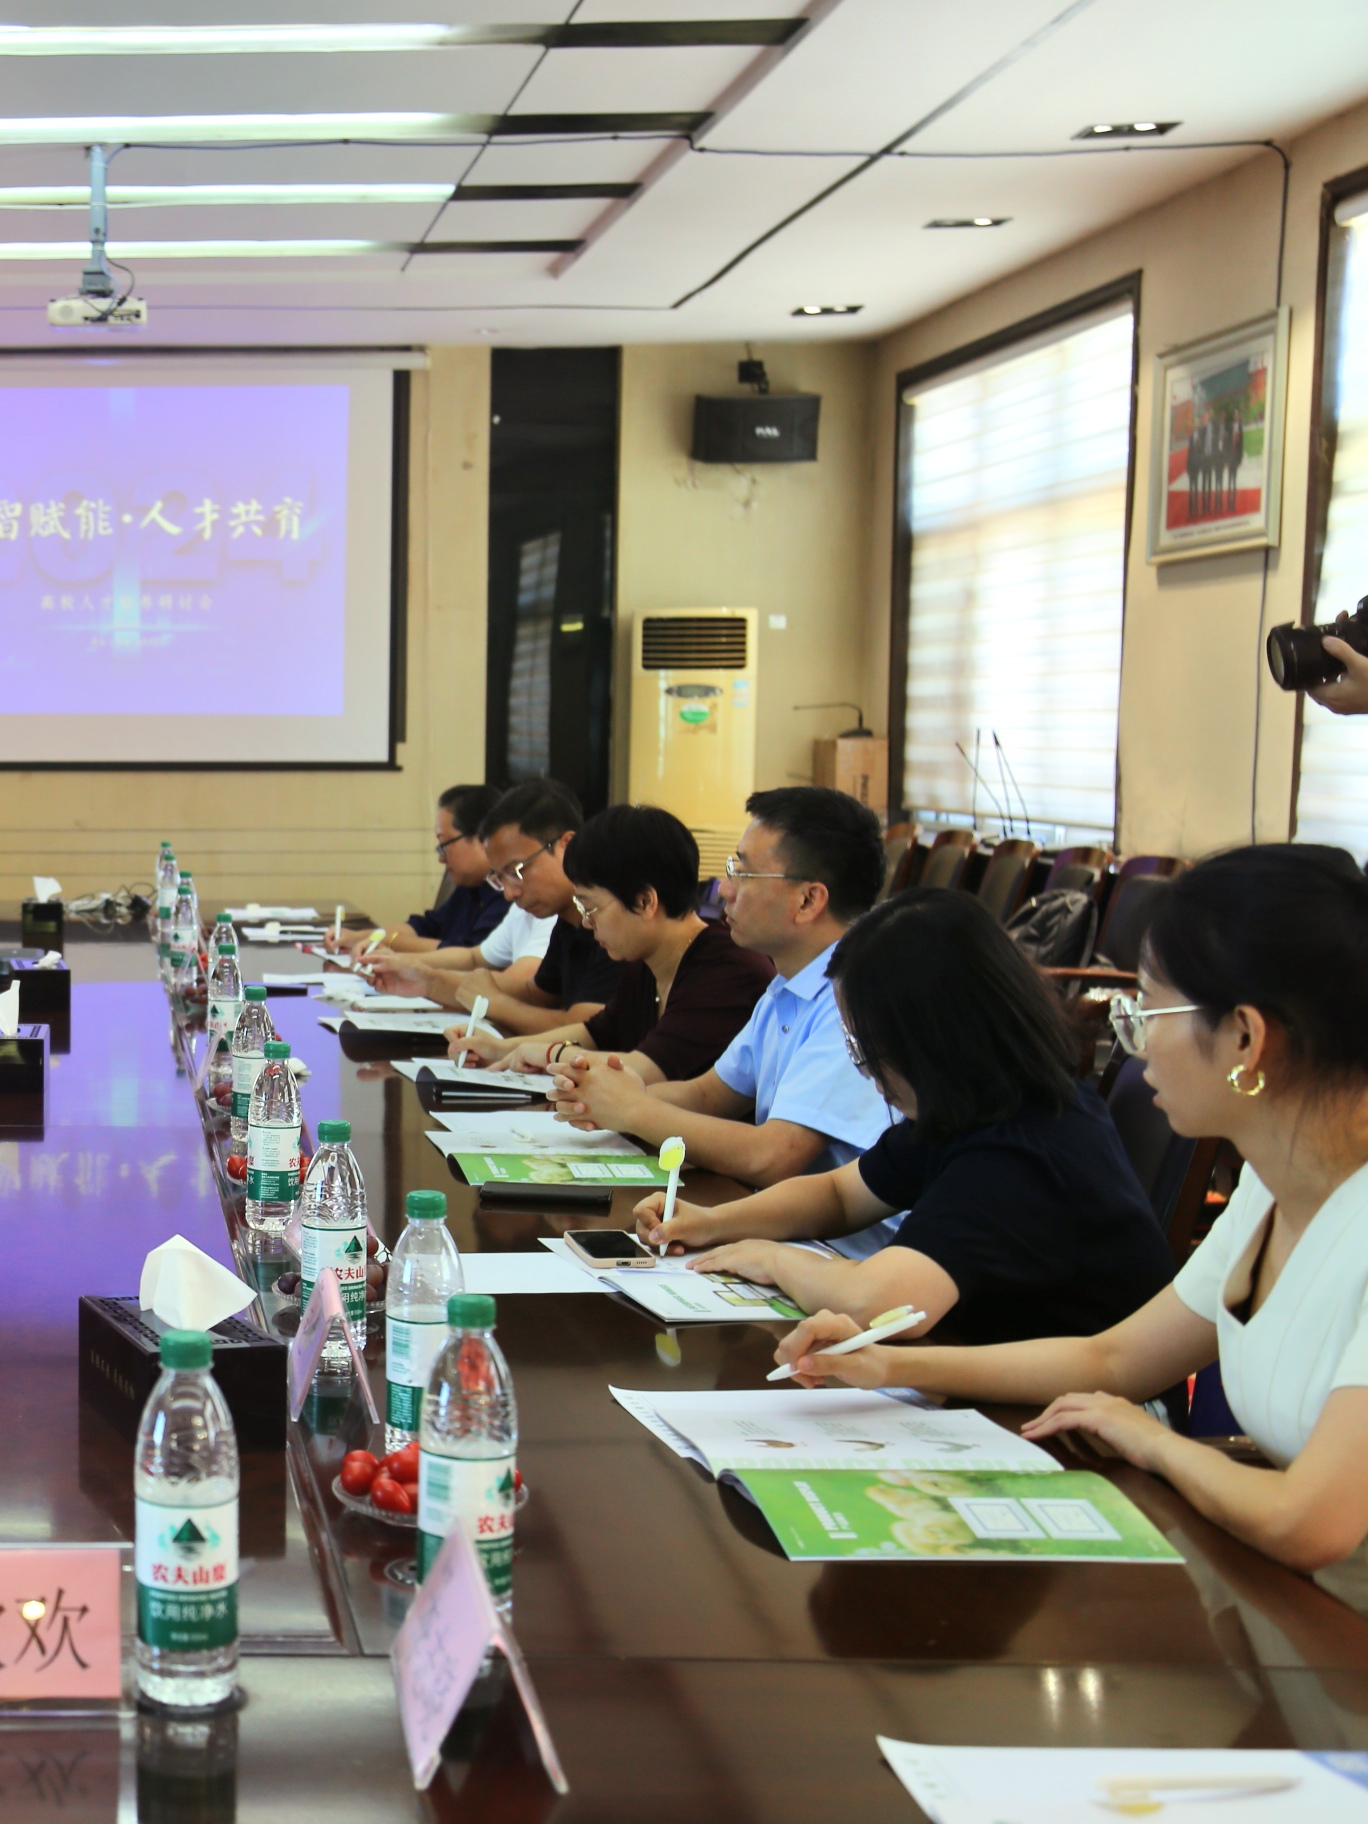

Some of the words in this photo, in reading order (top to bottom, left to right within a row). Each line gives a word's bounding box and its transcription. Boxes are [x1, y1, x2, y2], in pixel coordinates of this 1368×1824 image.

[335, 1265, 366, 1281] 农夫山
[152, 1563, 227, 1586] 农夫山泉
